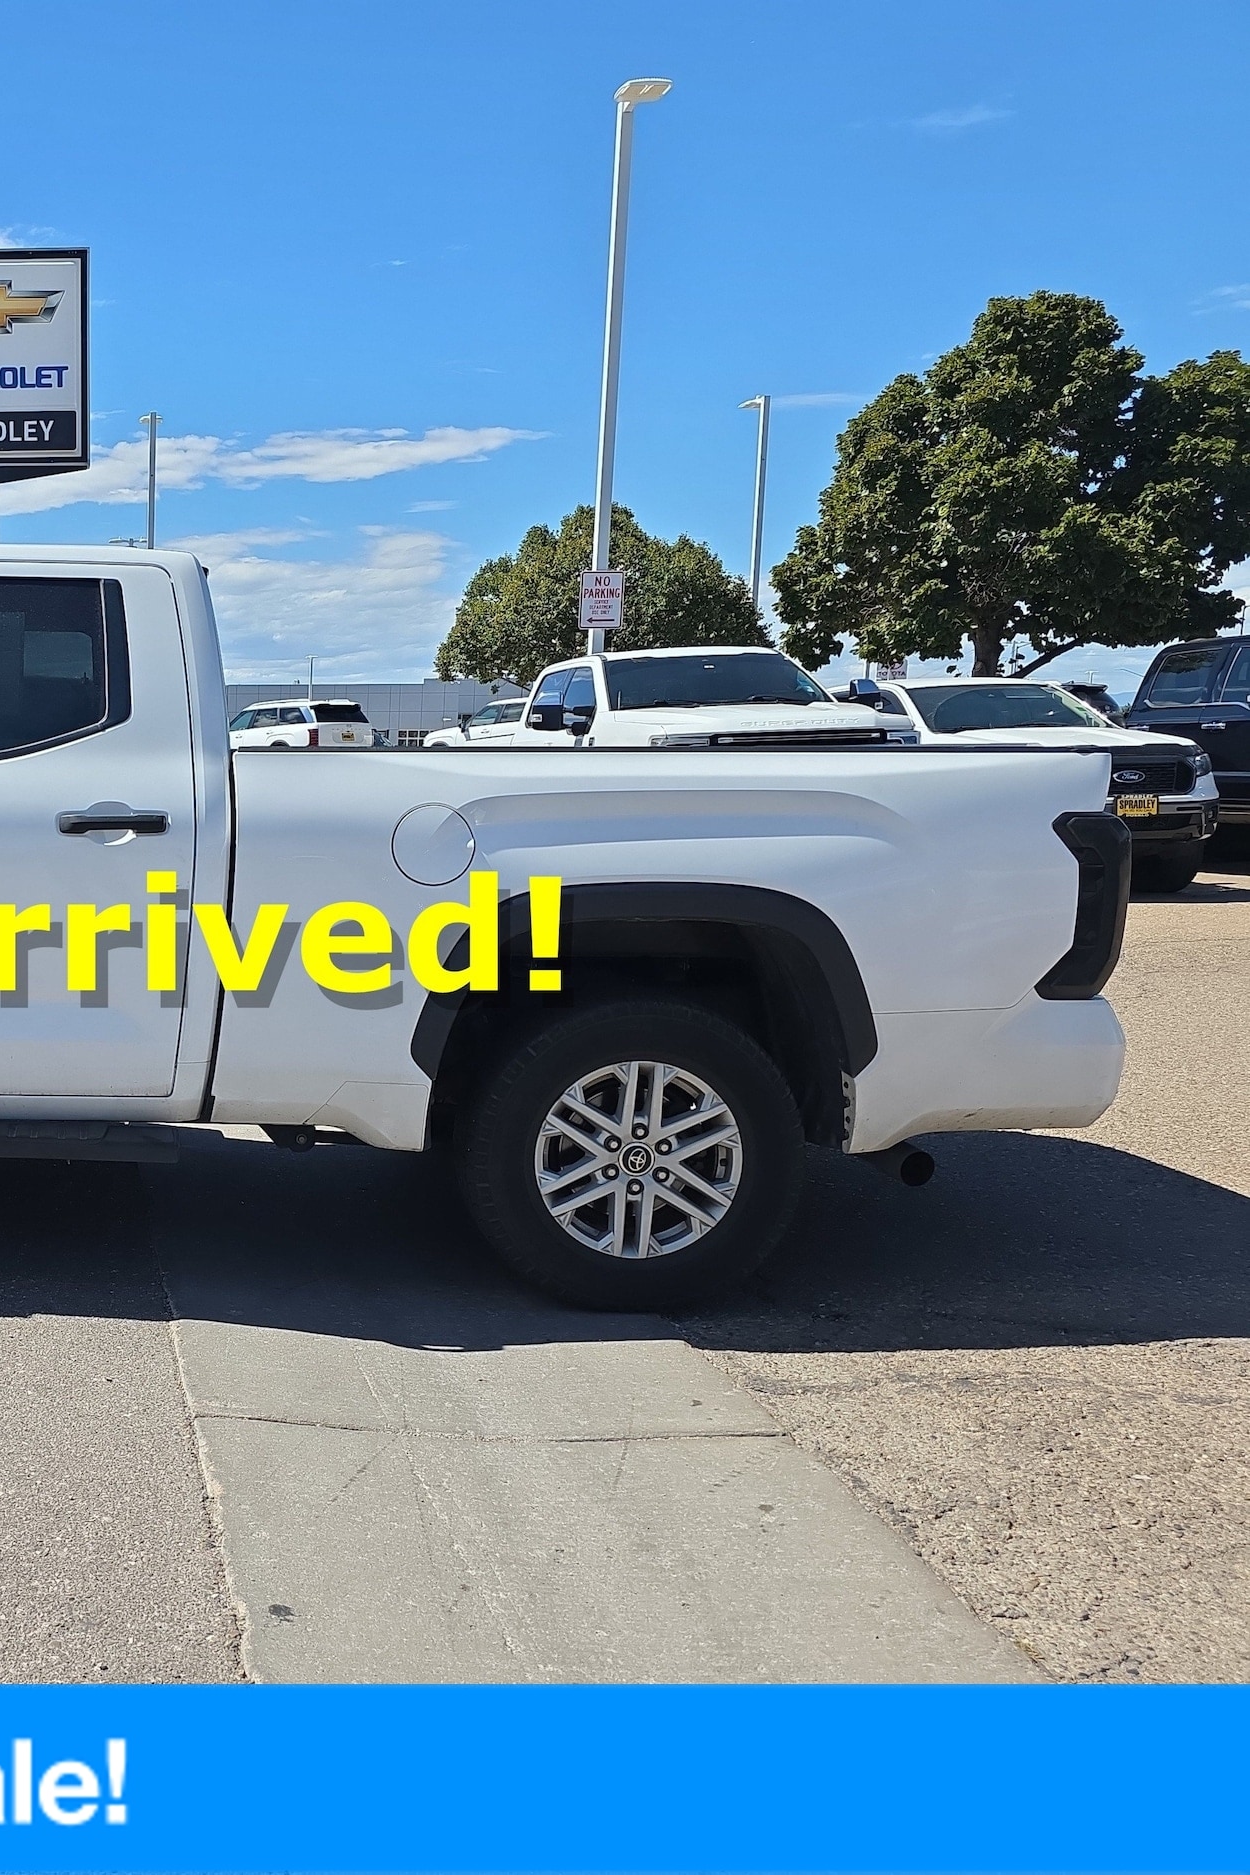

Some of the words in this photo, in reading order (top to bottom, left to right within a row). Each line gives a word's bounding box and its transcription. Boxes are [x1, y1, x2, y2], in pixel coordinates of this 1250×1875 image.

[595, 576, 611, 587] NO
[583, 588, 621, 599] PARKING
[811, 717, 860, 725] DUTY
[1121, 772, 1140, 780] Ford
[1119, 799, 1156, 809] SPRADLEY
